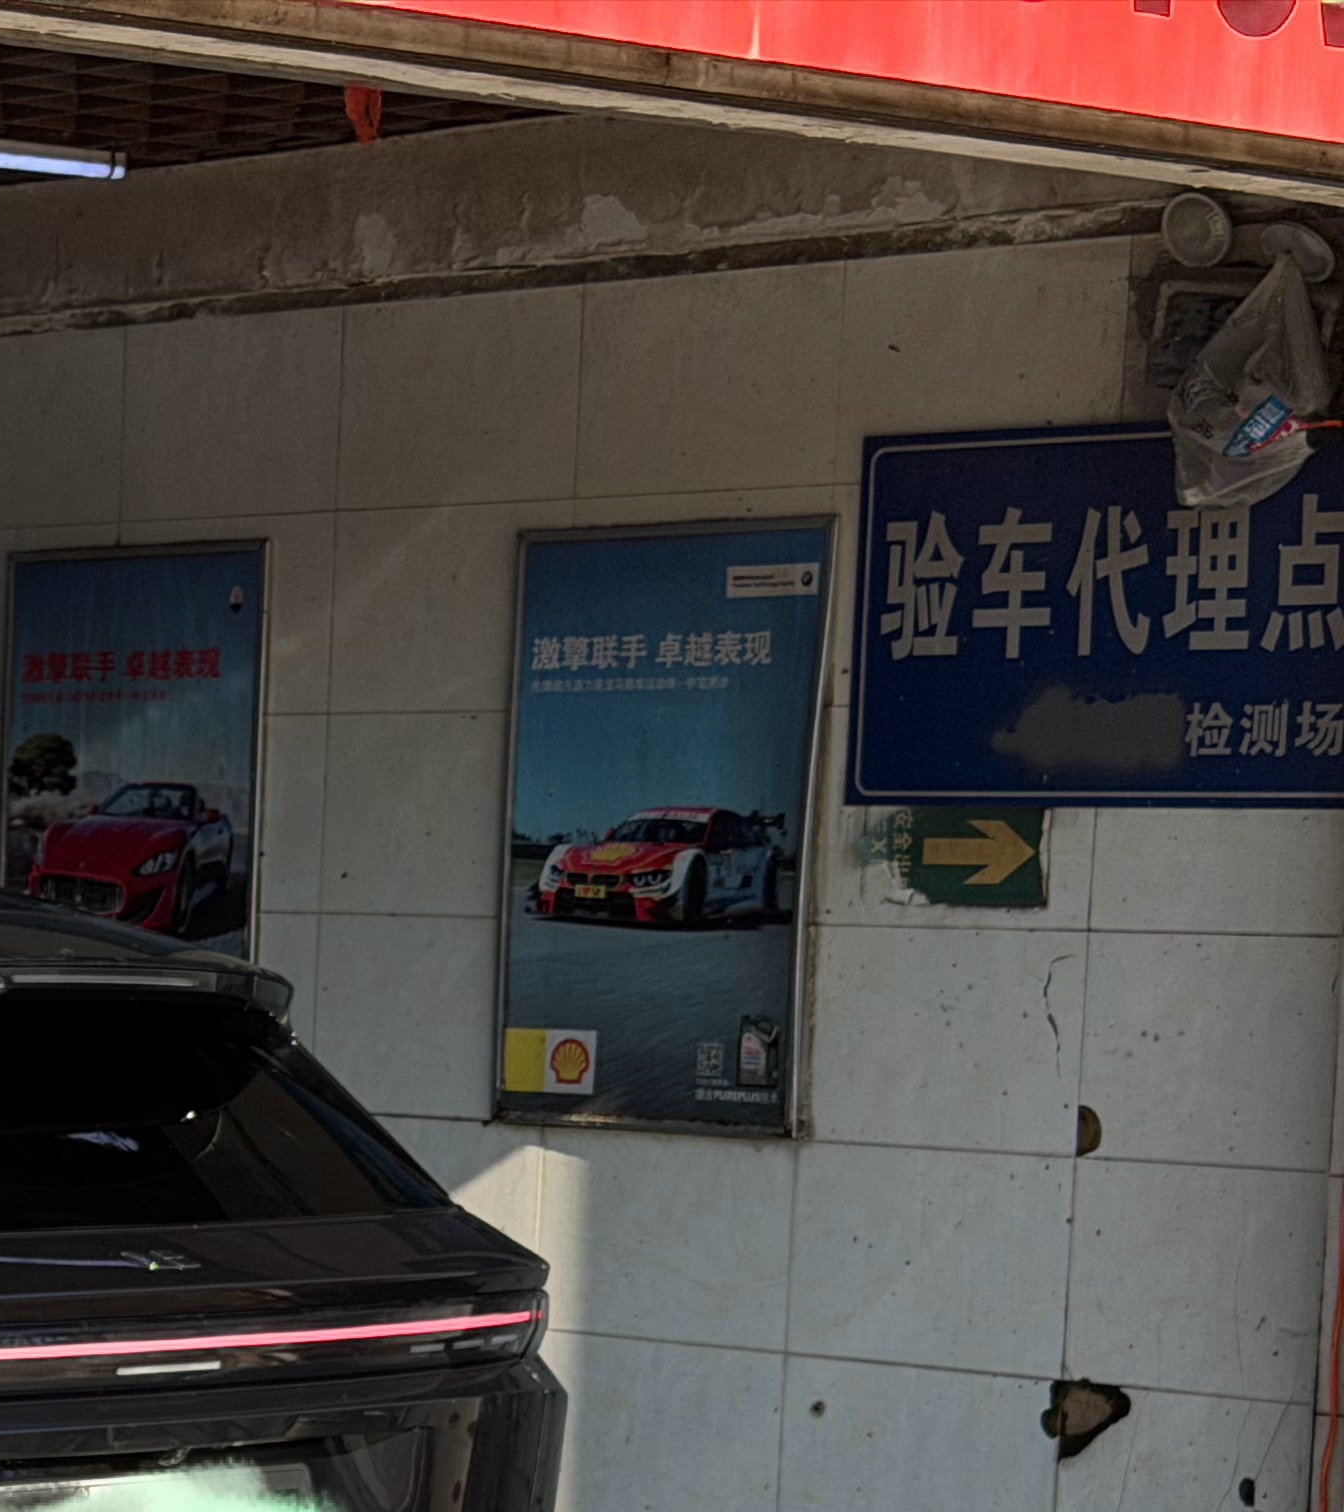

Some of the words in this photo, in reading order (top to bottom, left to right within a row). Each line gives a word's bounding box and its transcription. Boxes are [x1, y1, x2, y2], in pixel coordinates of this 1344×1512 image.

[879, 493, 1344, 663] 验车代理点
[655, 630, 773, 669] 卓越表现
[1184, 697, 1344, 759] 检测场
